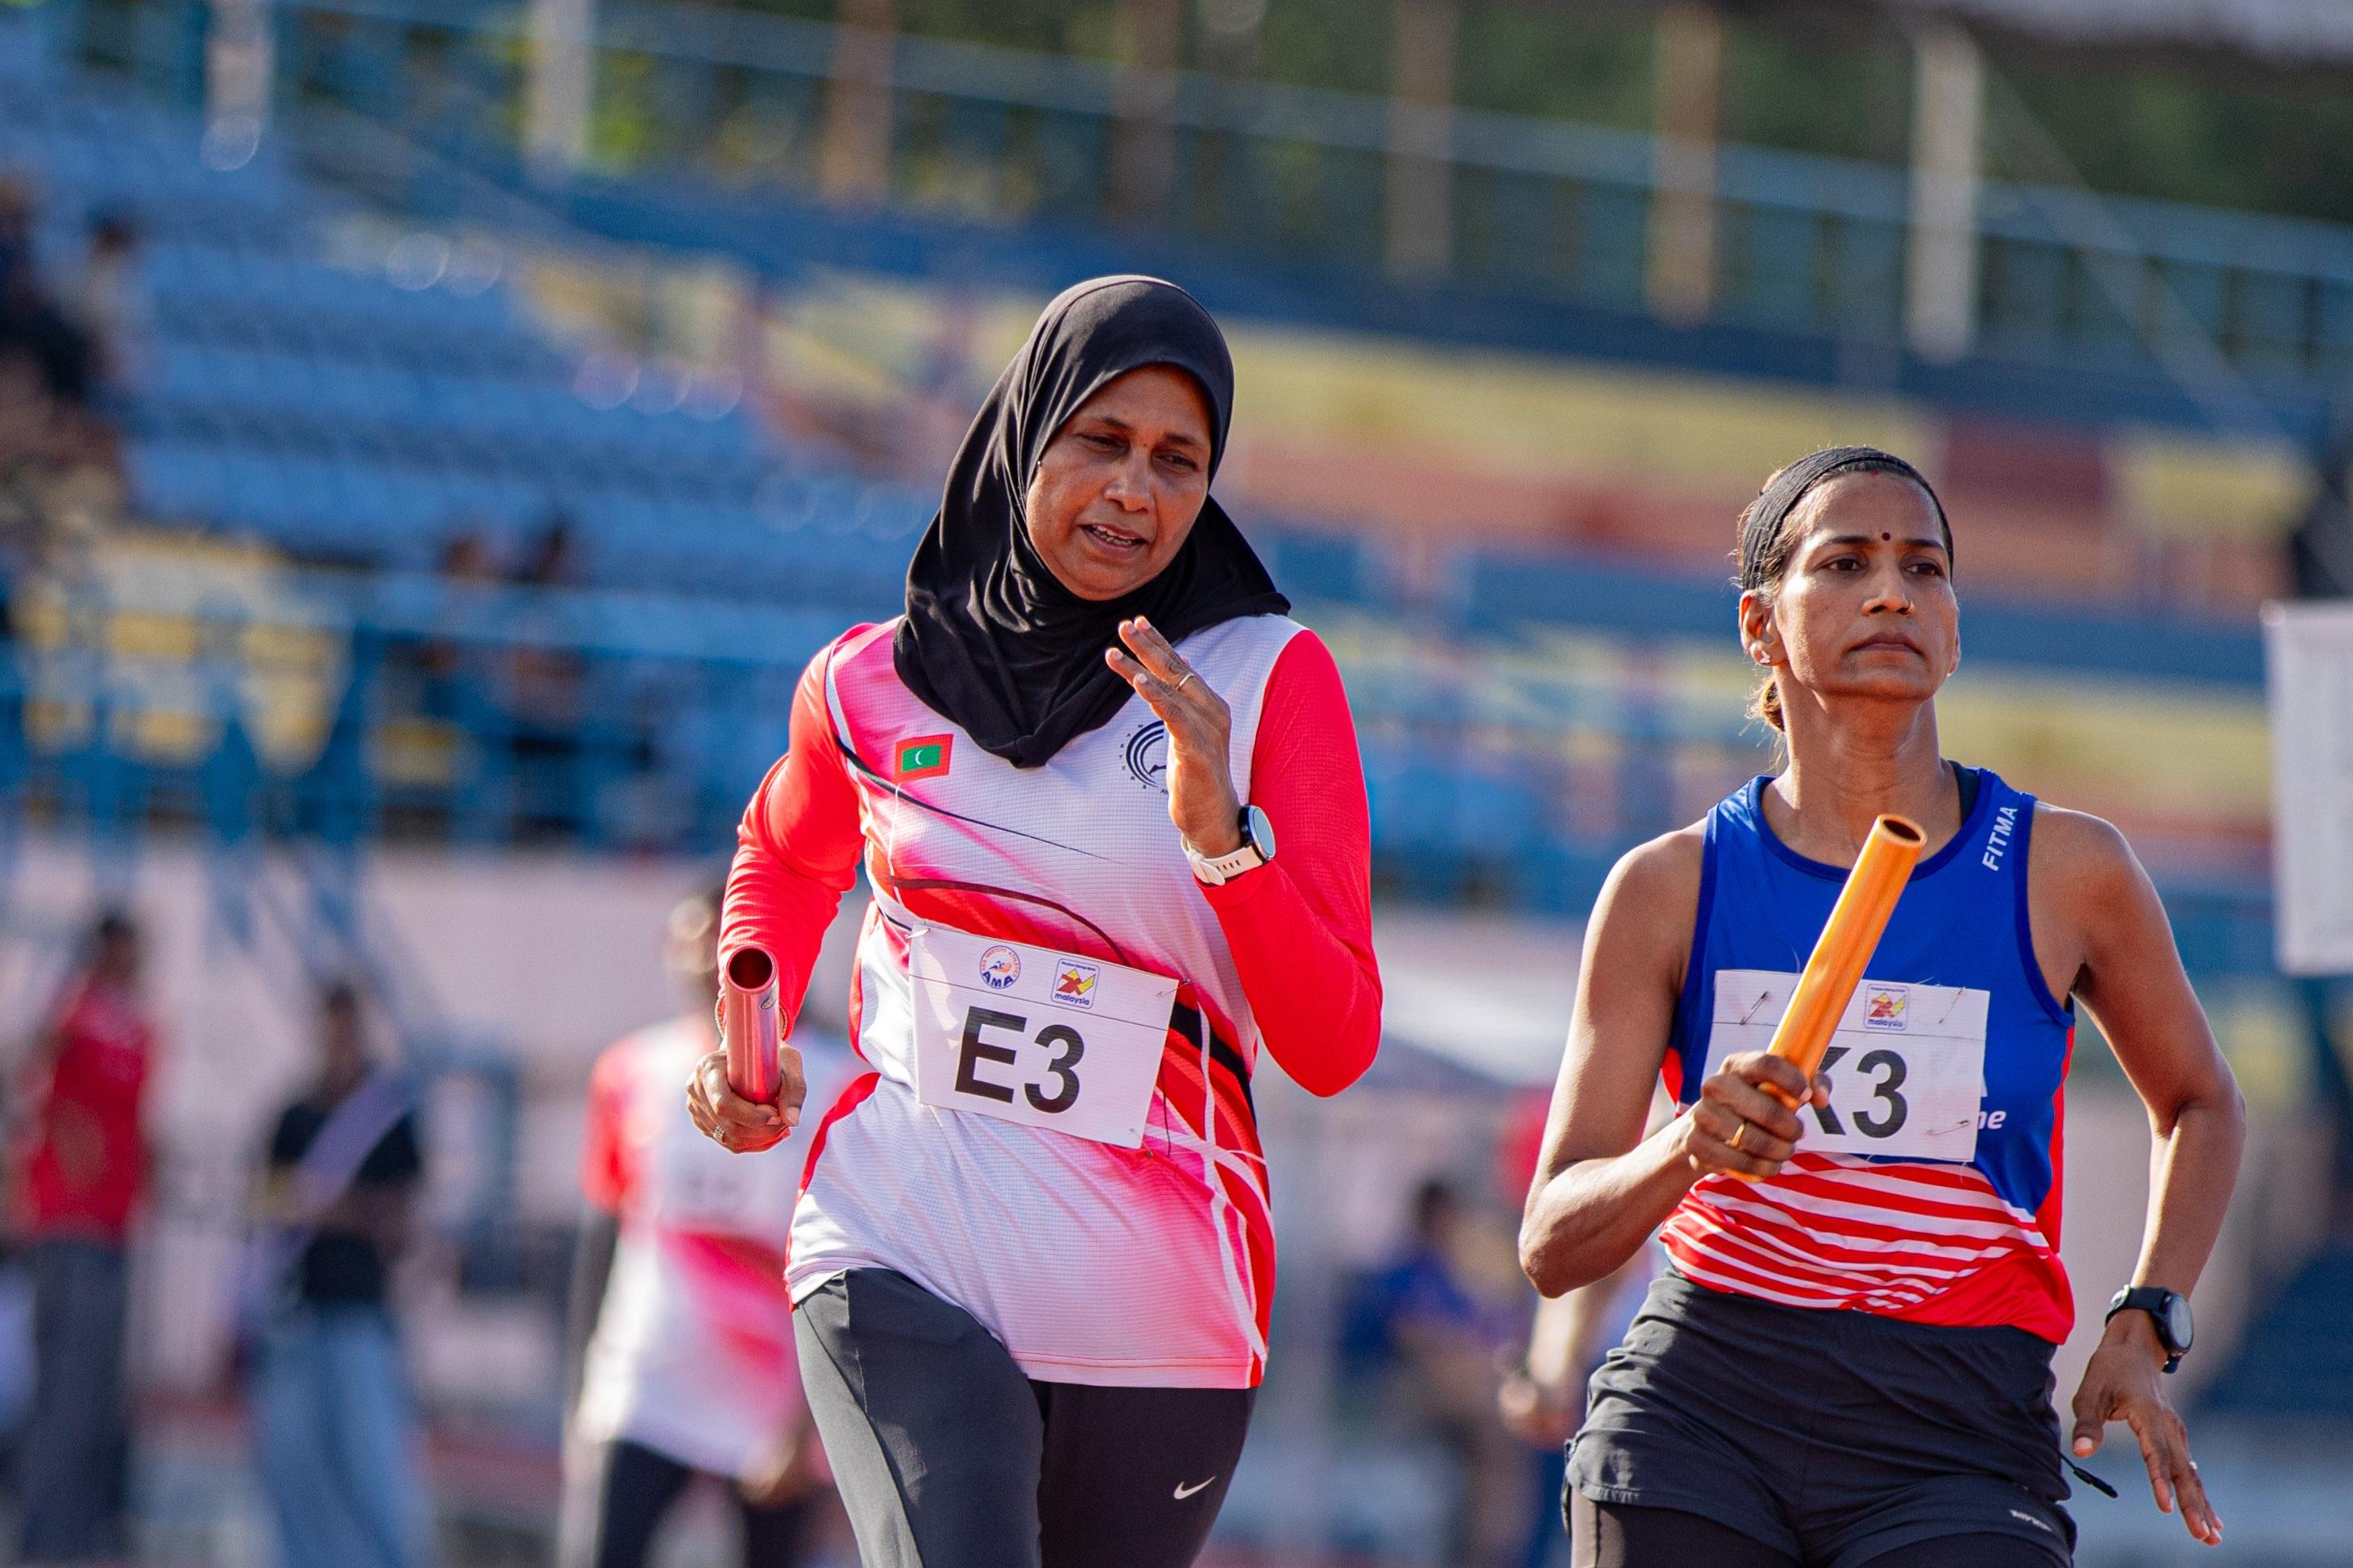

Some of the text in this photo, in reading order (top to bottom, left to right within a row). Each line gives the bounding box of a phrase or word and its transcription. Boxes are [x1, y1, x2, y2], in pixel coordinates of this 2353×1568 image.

[1982, 807, 2018, 871] FITMA
[982, 971, 1014, 987] AMA
[1055, 993, 1090, 1006] malaysia
[1867, 1018, 1903, 1027] malaysia
[955, 1006, 1085, 1114] E3
